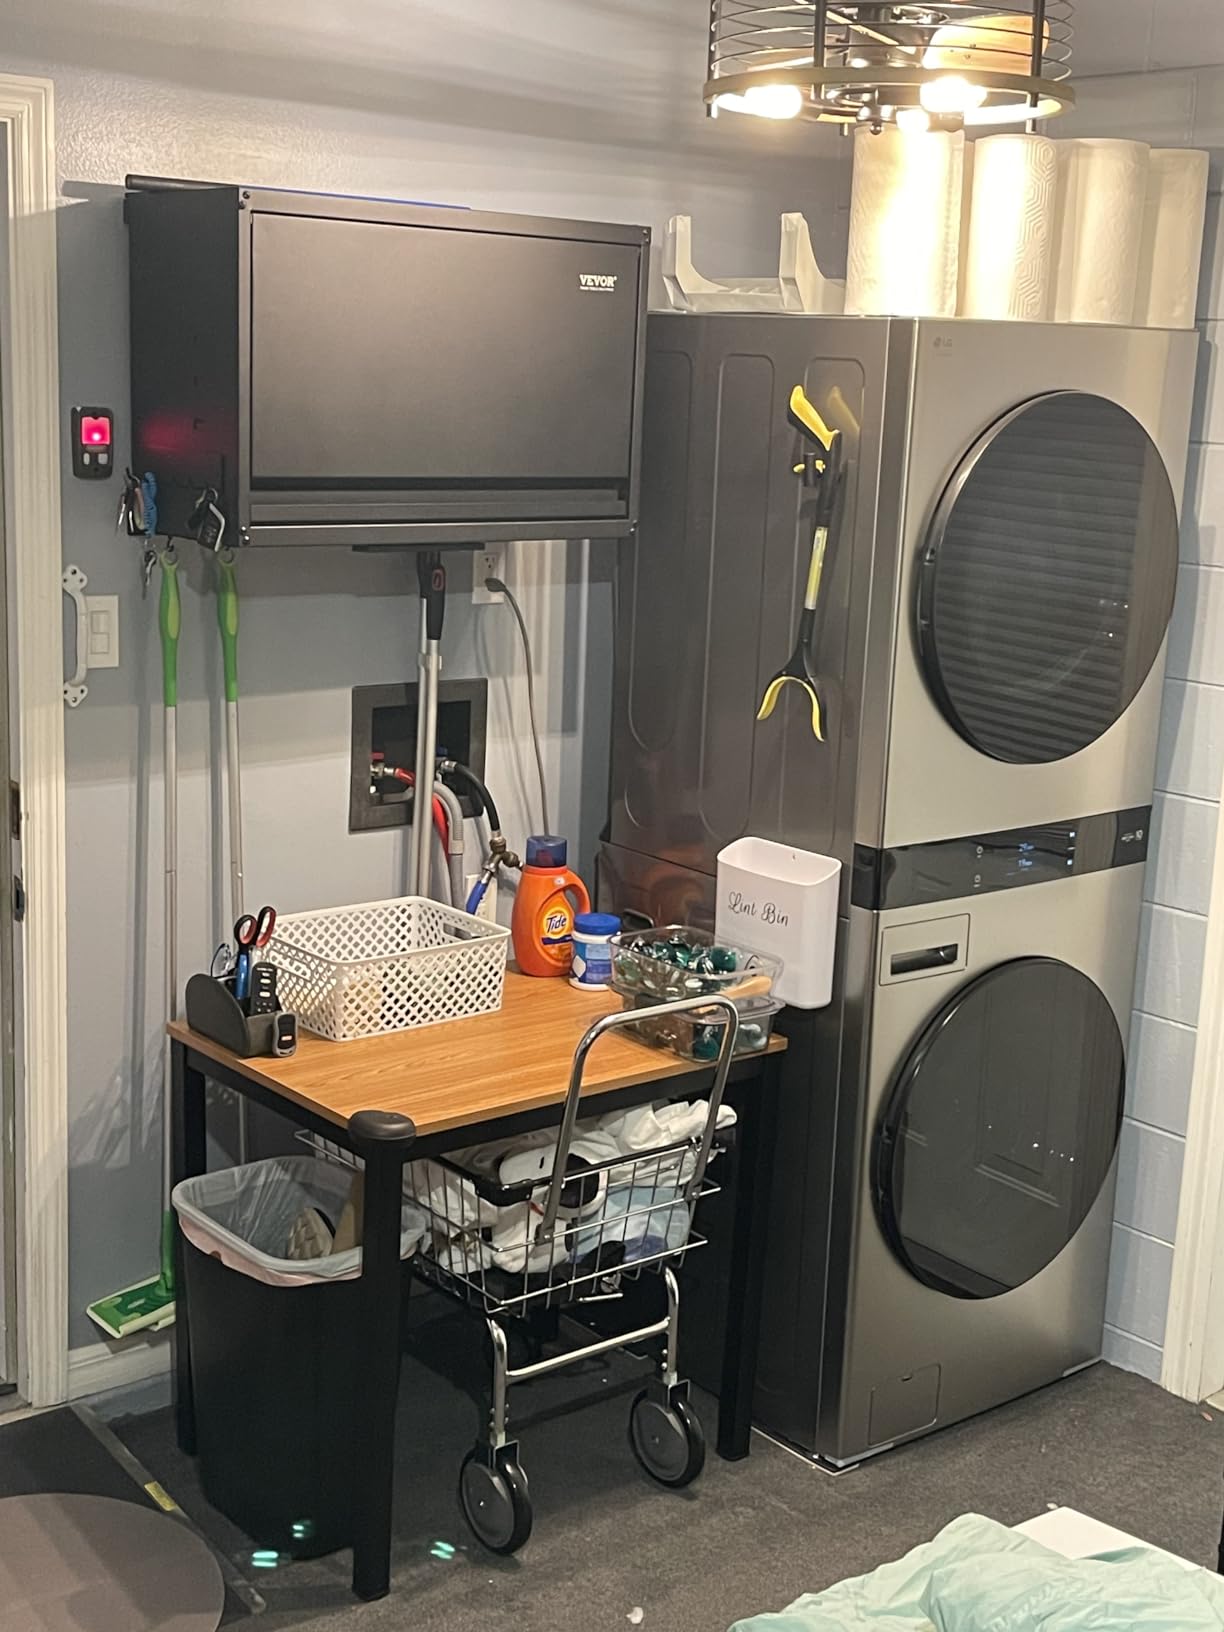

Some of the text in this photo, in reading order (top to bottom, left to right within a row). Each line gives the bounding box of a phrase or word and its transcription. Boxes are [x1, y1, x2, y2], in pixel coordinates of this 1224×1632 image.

[728, 891, 789, 927] Lint Bin
[546, 914, 567, 933] Tide
